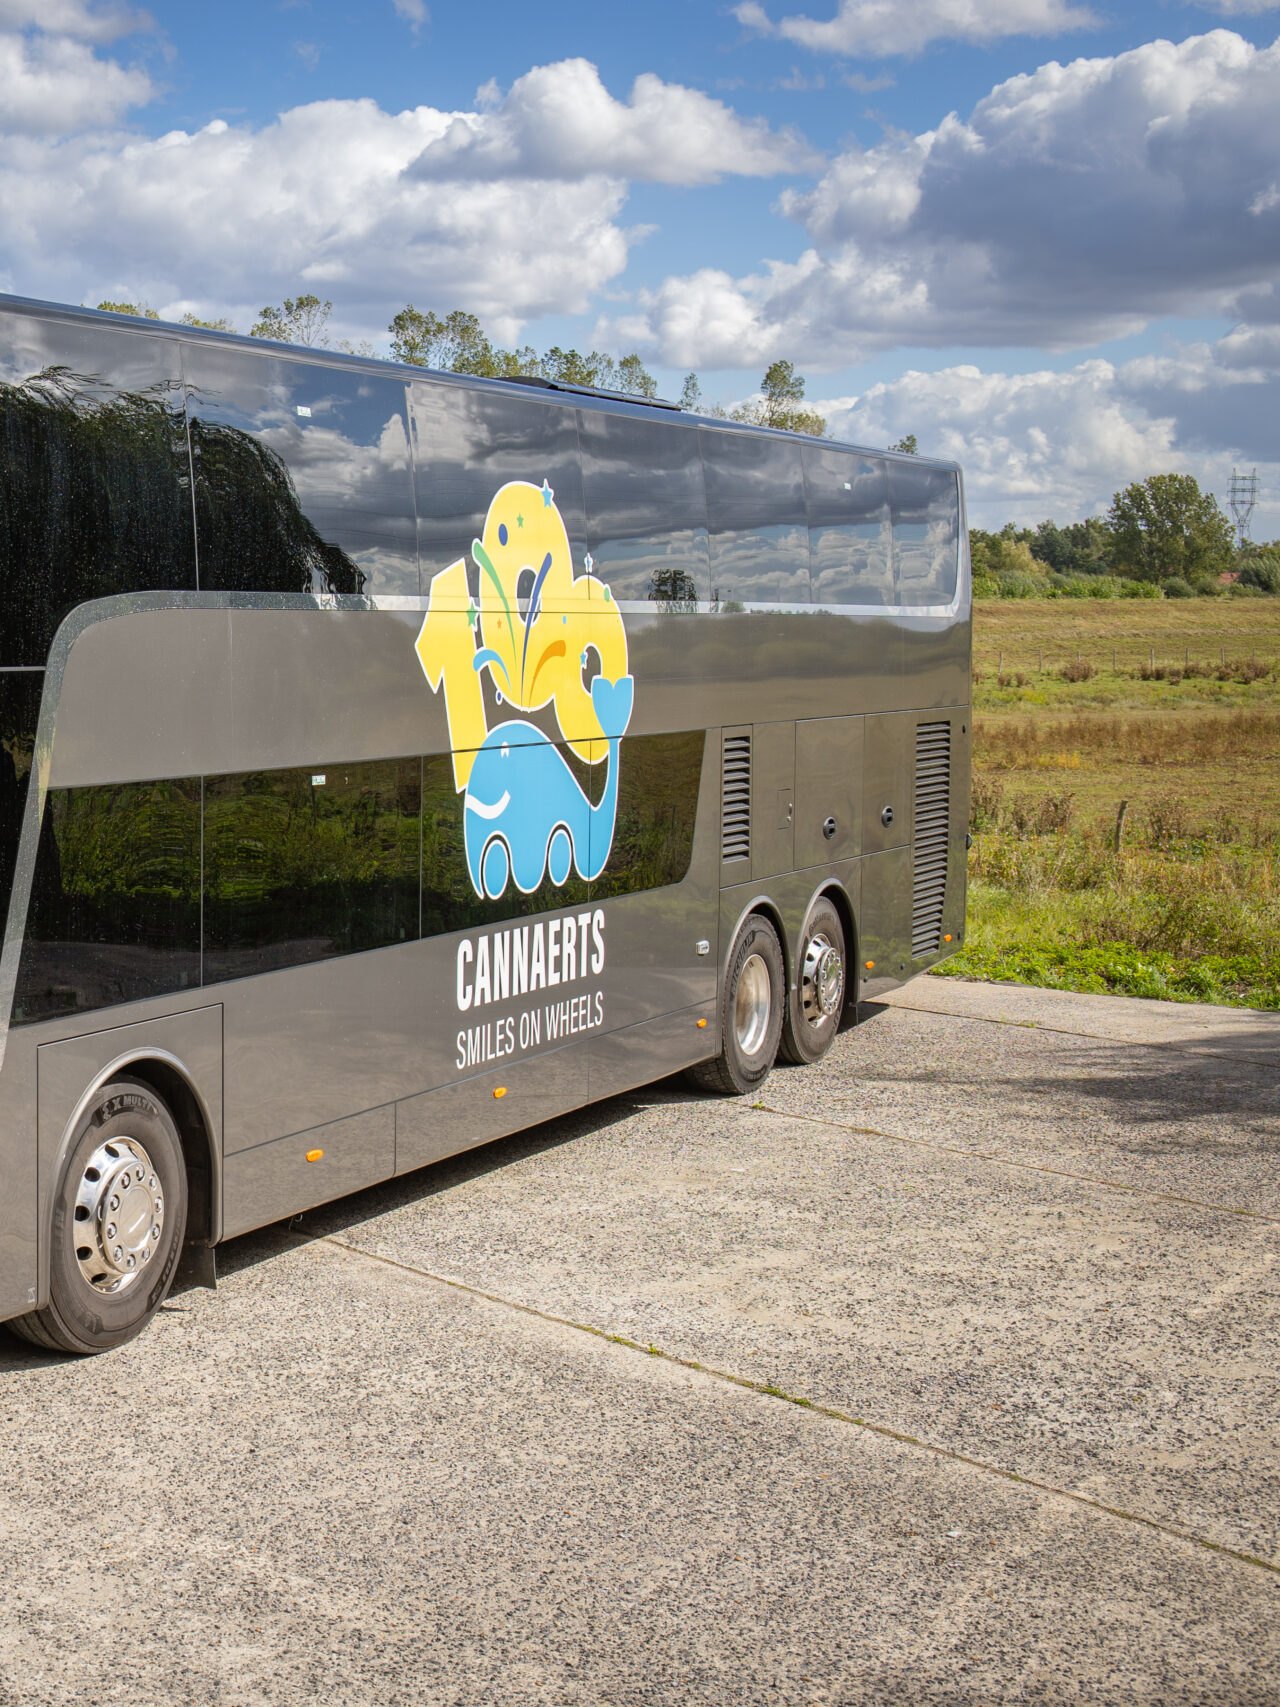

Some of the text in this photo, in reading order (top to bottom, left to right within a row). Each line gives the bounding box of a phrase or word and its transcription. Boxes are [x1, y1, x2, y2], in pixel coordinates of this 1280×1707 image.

[456, 908, 605, 1011] CANNAERTS
[456, 990, 603, 1070] SMILES ON WHEELS
